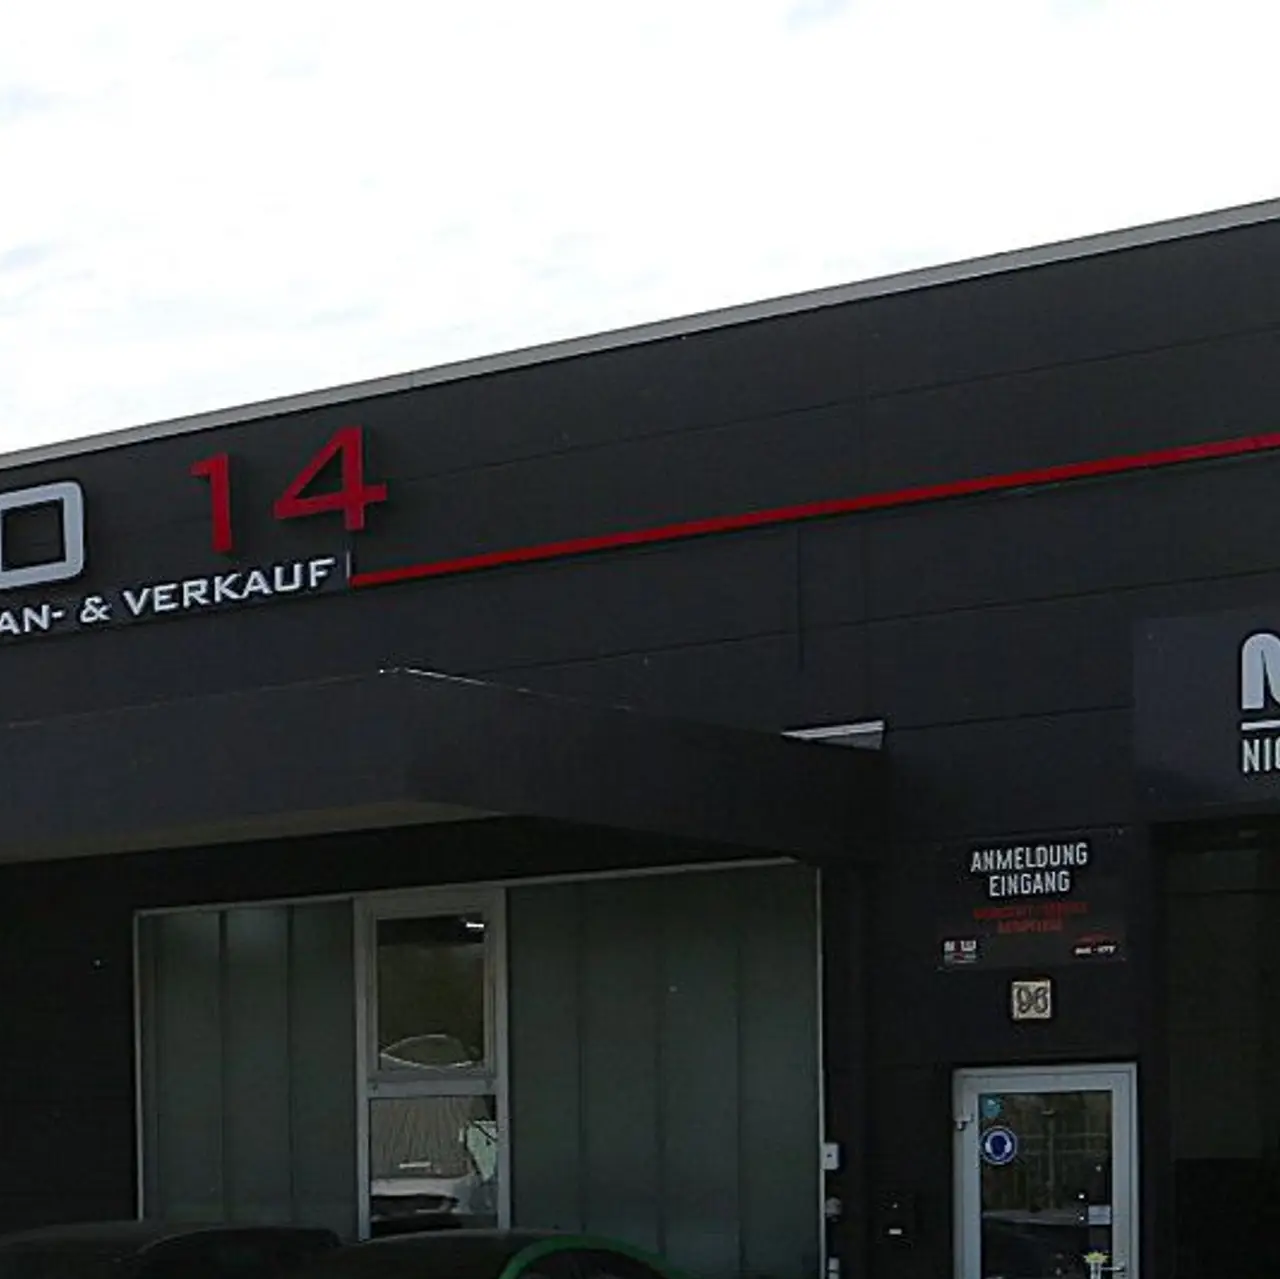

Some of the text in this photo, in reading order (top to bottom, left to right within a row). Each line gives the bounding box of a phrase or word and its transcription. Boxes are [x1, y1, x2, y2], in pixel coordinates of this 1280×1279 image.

[190, 425, 389, 553] 14
[79, 595, 110, 624] &
[126, 557, 336, 617] VERKAUF
[970, 841, 1089, 873] ANMELDUNG
[988, 870, 1072, 898] EINGANG
